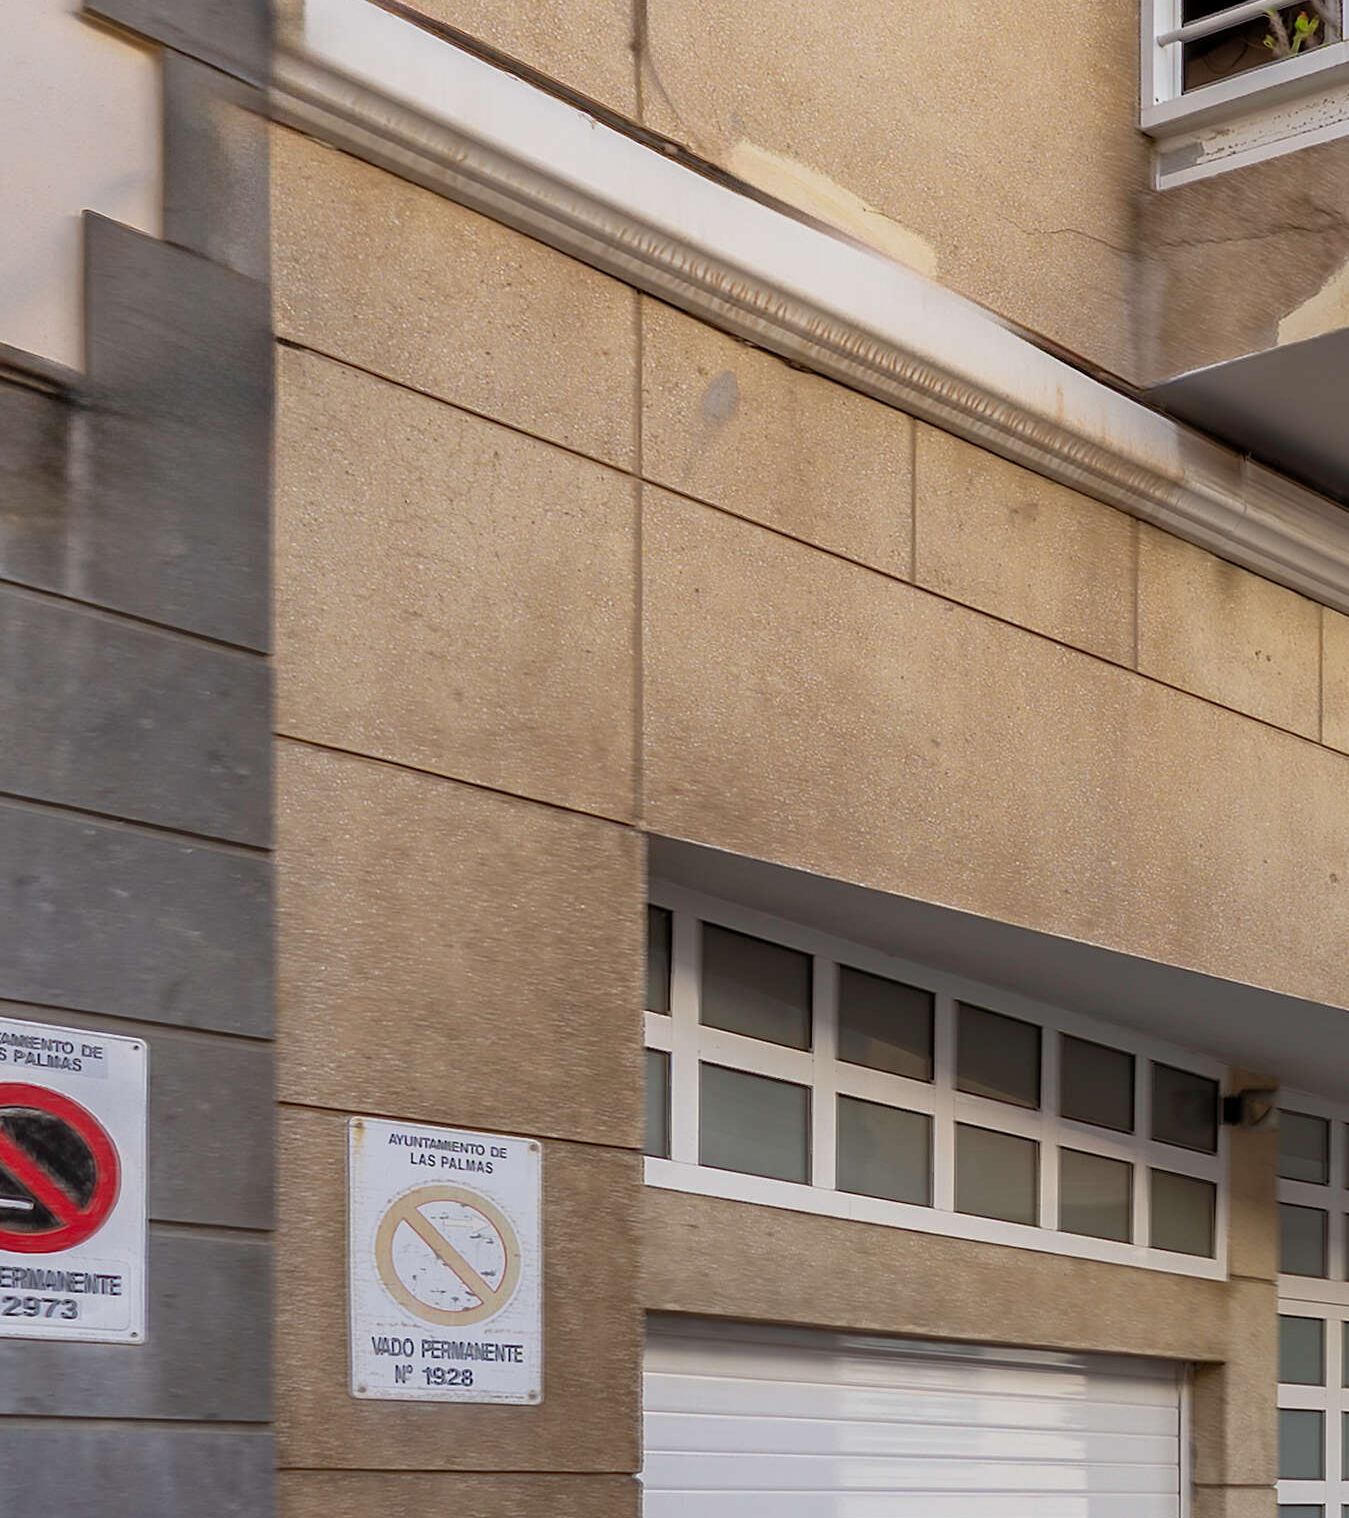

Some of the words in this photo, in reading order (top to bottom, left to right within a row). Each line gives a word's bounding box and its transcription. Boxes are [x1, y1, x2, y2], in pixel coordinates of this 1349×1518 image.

[0, 1031, 74, 1055] AMIENTO
[81, 1044, 103, 1060] DE
[14, 1049, 82, 1072] PALMAS
[388, 1133, 485, 1156] AYUNTAMIENTO
[490, 1146, 508, 1159] DE
[410, 1152, 436, 1167] LAS
[441, 1155, 494, 1174] PALMAS
[1, 1296, 79, 1320] 2973
[371, 1336, 415, 1358] VADO
[421, 1339, 524, 1363] PERMANENTE
[422, 1366, 474, 1387] 1928
